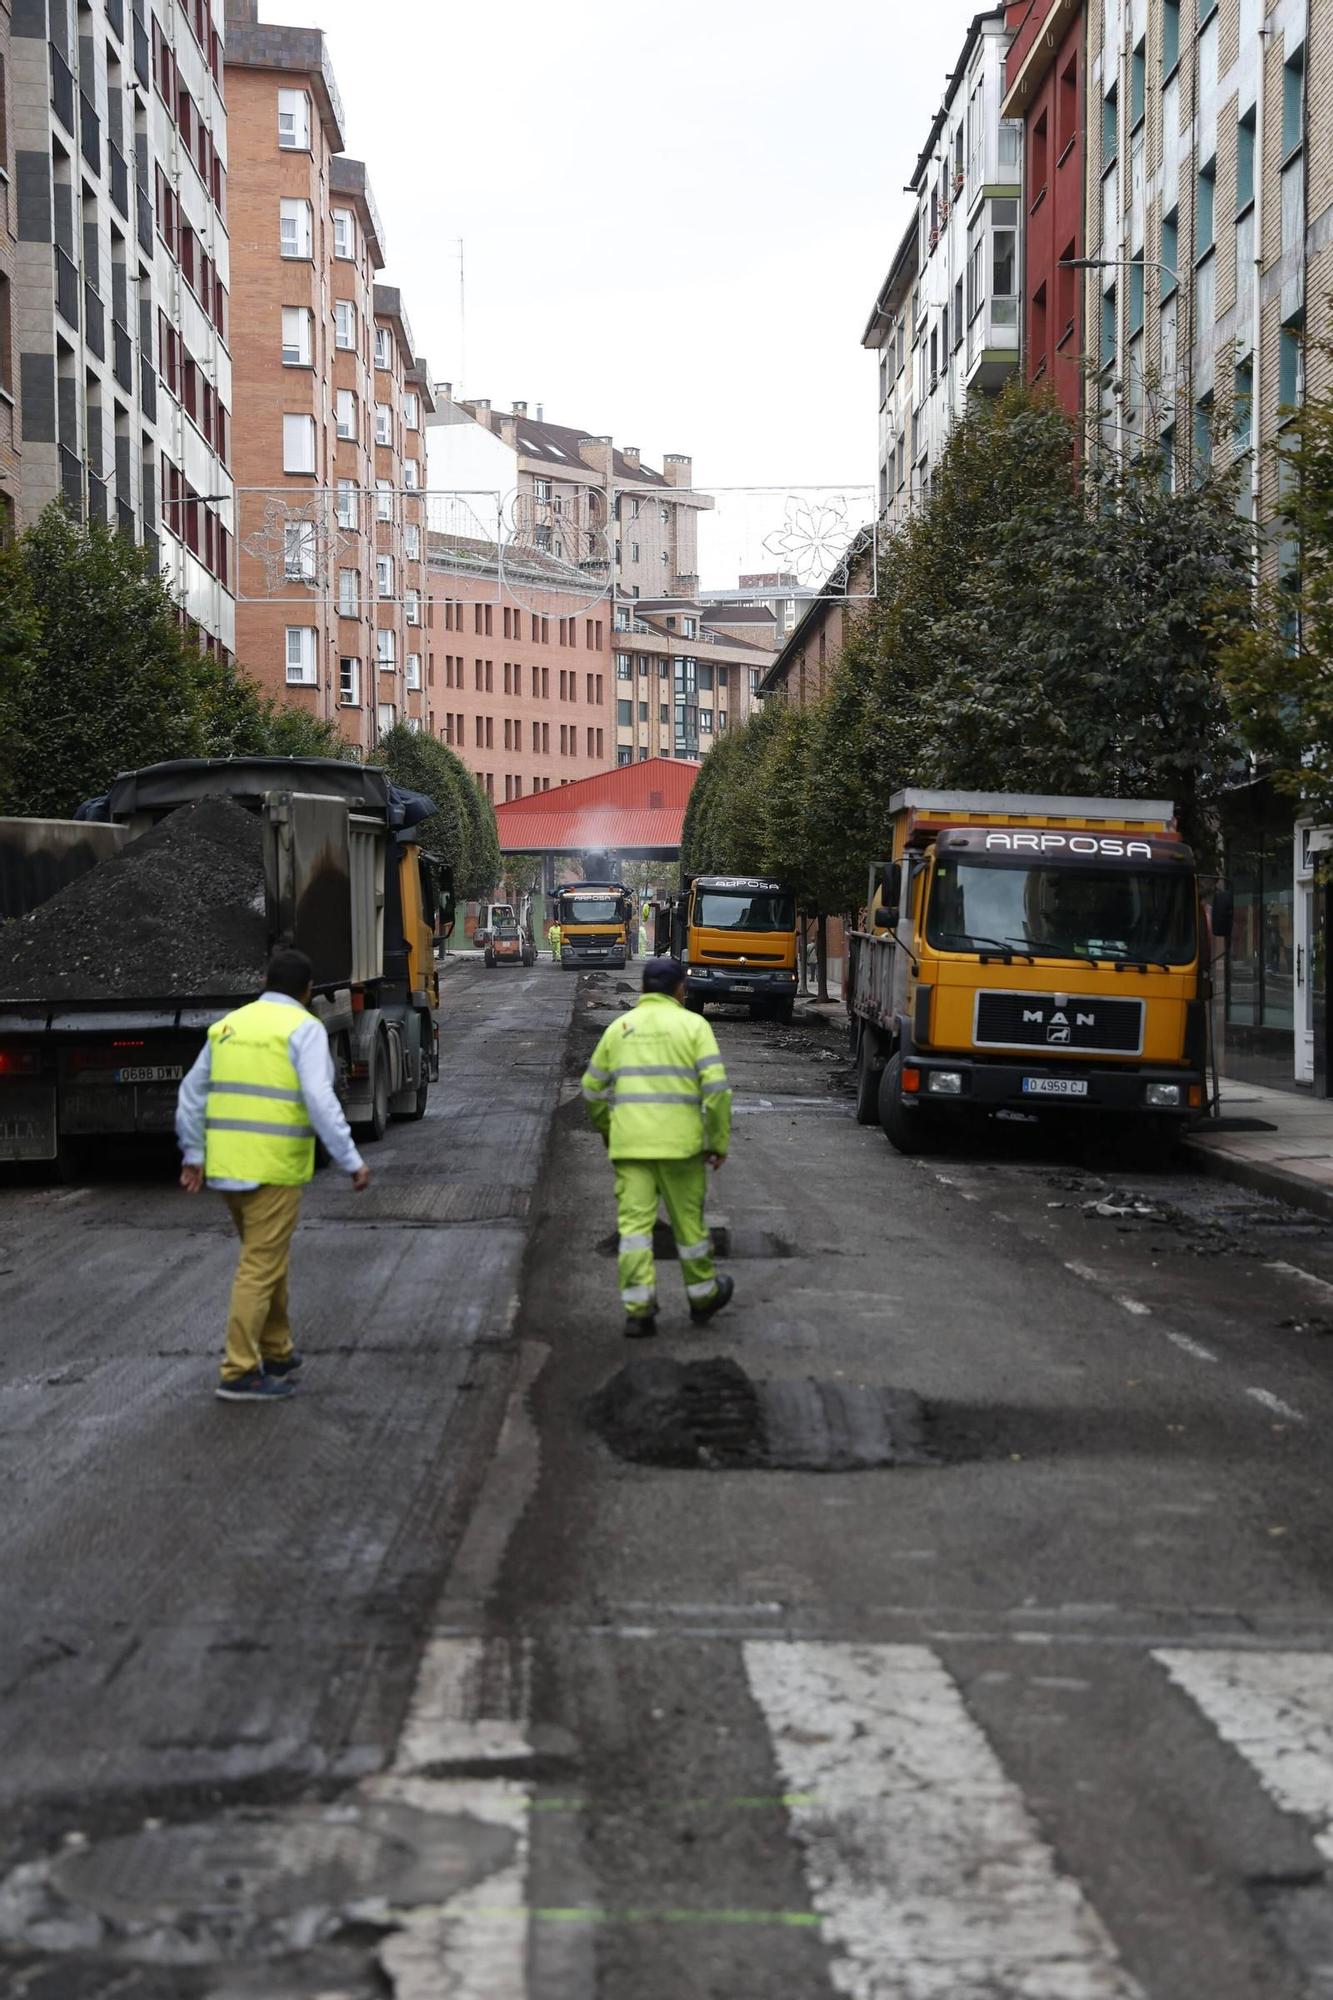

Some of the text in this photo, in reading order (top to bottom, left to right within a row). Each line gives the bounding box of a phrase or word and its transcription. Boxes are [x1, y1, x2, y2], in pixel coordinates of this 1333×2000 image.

[985, 833, 1152, 859] ARPOSA
[715, 880, 780, 890] ARPOSA
[1022, 1009, 1095, 1026] MAN
[1040, 1080, 1067, 1092] 4959
[1070, 1081, 1085, 1093] CJ
